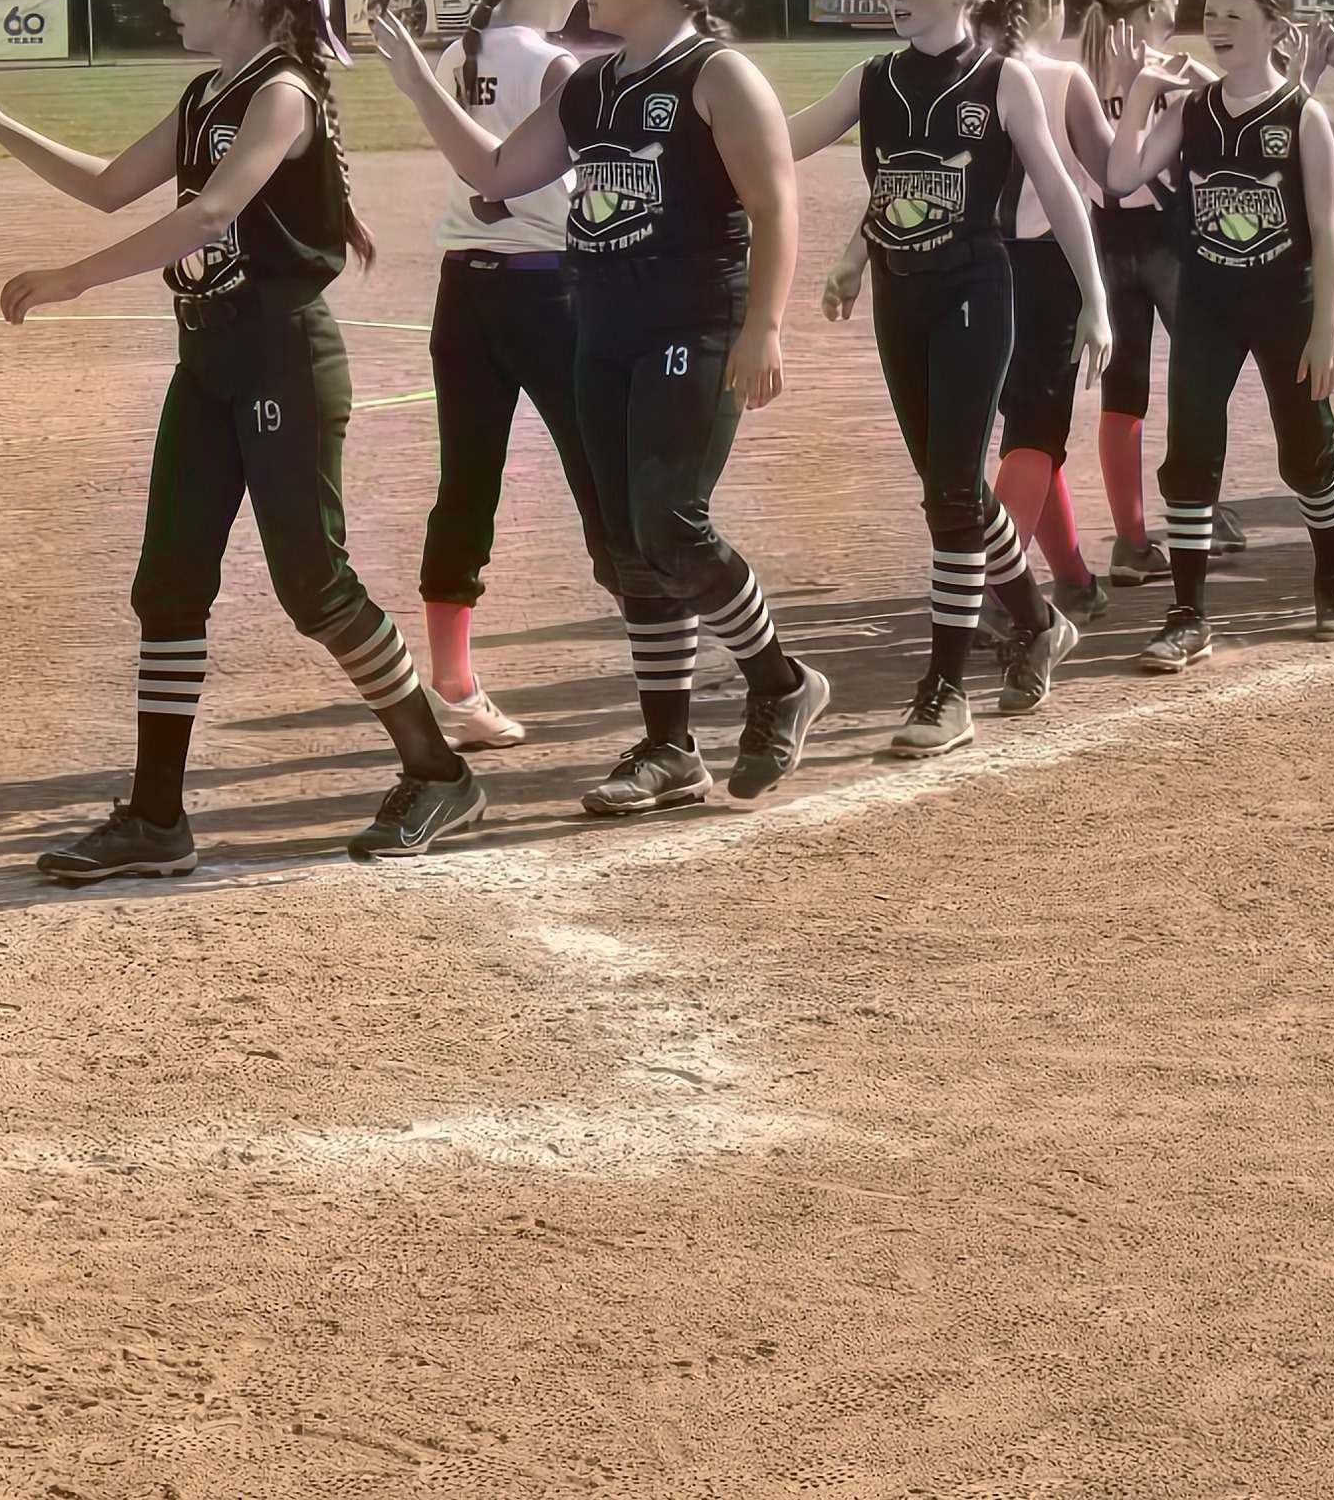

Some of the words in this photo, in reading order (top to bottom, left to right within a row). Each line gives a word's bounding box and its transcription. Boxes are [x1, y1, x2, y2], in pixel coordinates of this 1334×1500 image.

[3, 5, 45, 36] 60
[960, 300, 970, 328] 1
[664, 344, 689, 377] 13
[253, 399, 282, 433] 19
